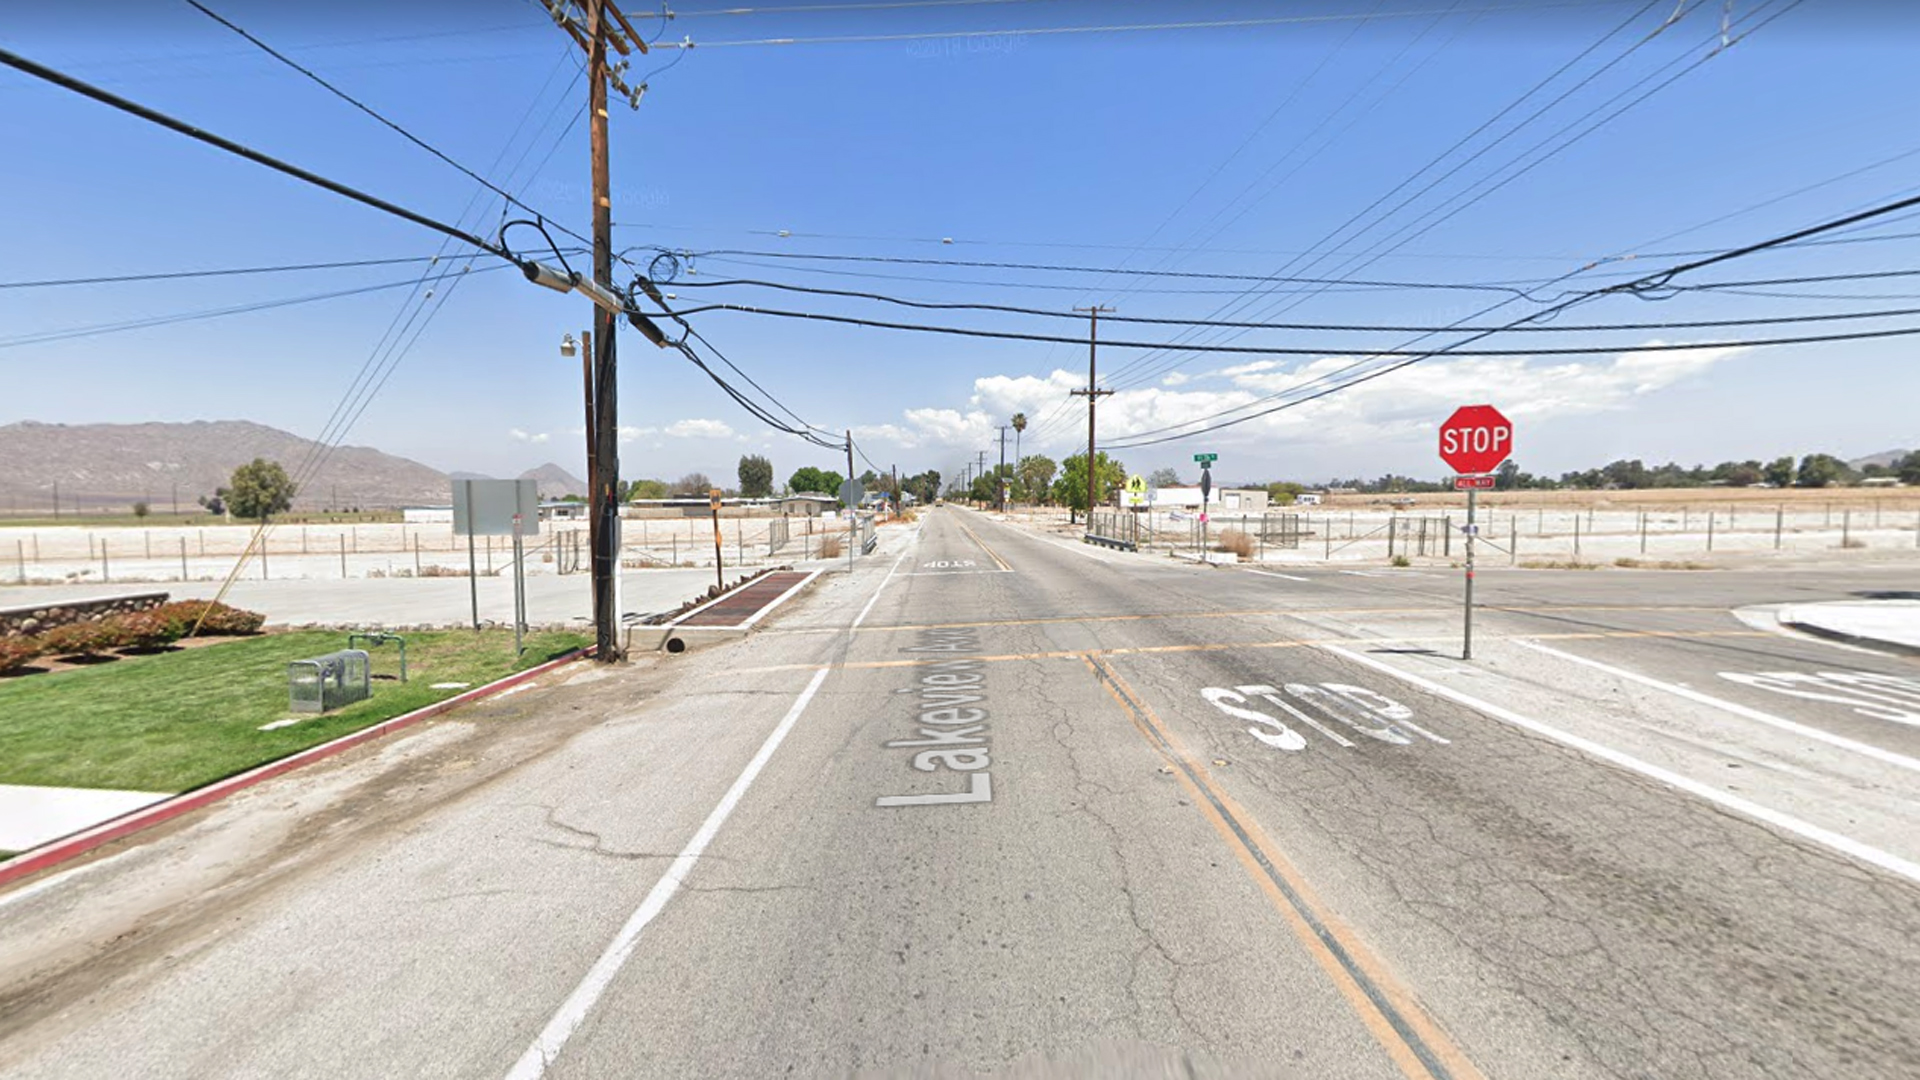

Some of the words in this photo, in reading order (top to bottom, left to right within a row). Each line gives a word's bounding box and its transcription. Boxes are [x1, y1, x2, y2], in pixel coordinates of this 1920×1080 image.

[1444, 426, 1509, 454] STOP
[1458, 480, 1472, 488] ALL
[1200, 682, 1452, 751] STOP
